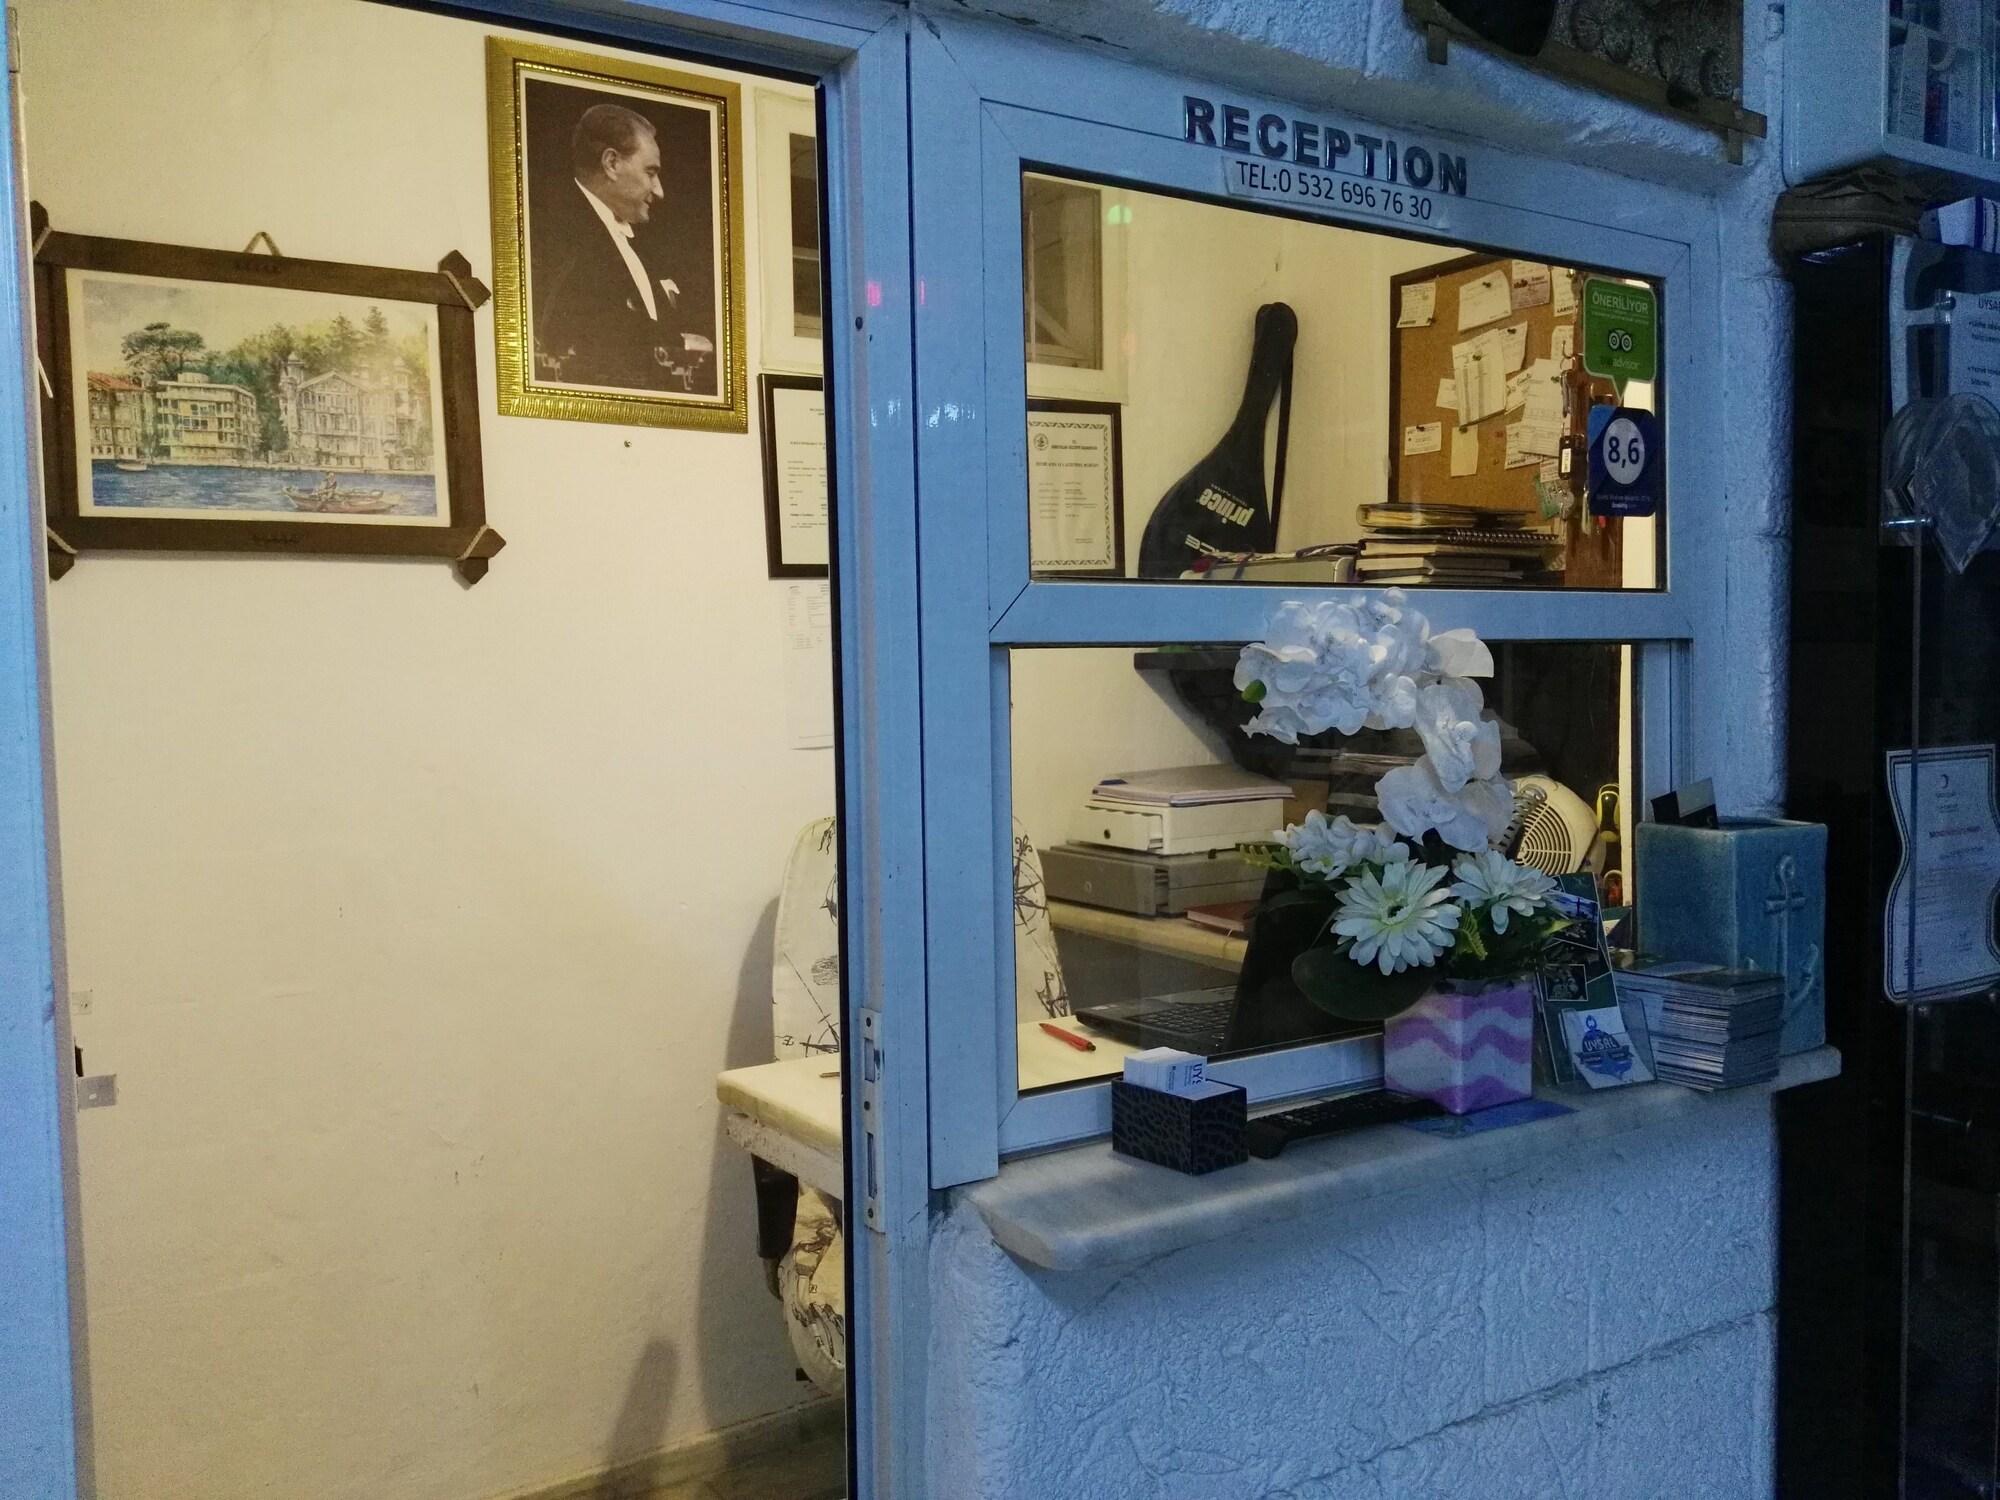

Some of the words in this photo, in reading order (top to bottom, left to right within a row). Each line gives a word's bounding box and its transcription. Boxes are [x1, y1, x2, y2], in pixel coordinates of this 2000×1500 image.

[1183, 95, 1467, 196] RECEPTION
[1298, 172, 1335, 201] 532
[1341, 181, 1376, 208] 696
[1381, 189, 1403, 215] 76
[1409, 196, 1432, 220] 30
[1608, 437, 1640, 468] 8,6
[1200, 488, 1255, 527] prince
[1584, 1037, 1617, 1051] UYSAL
